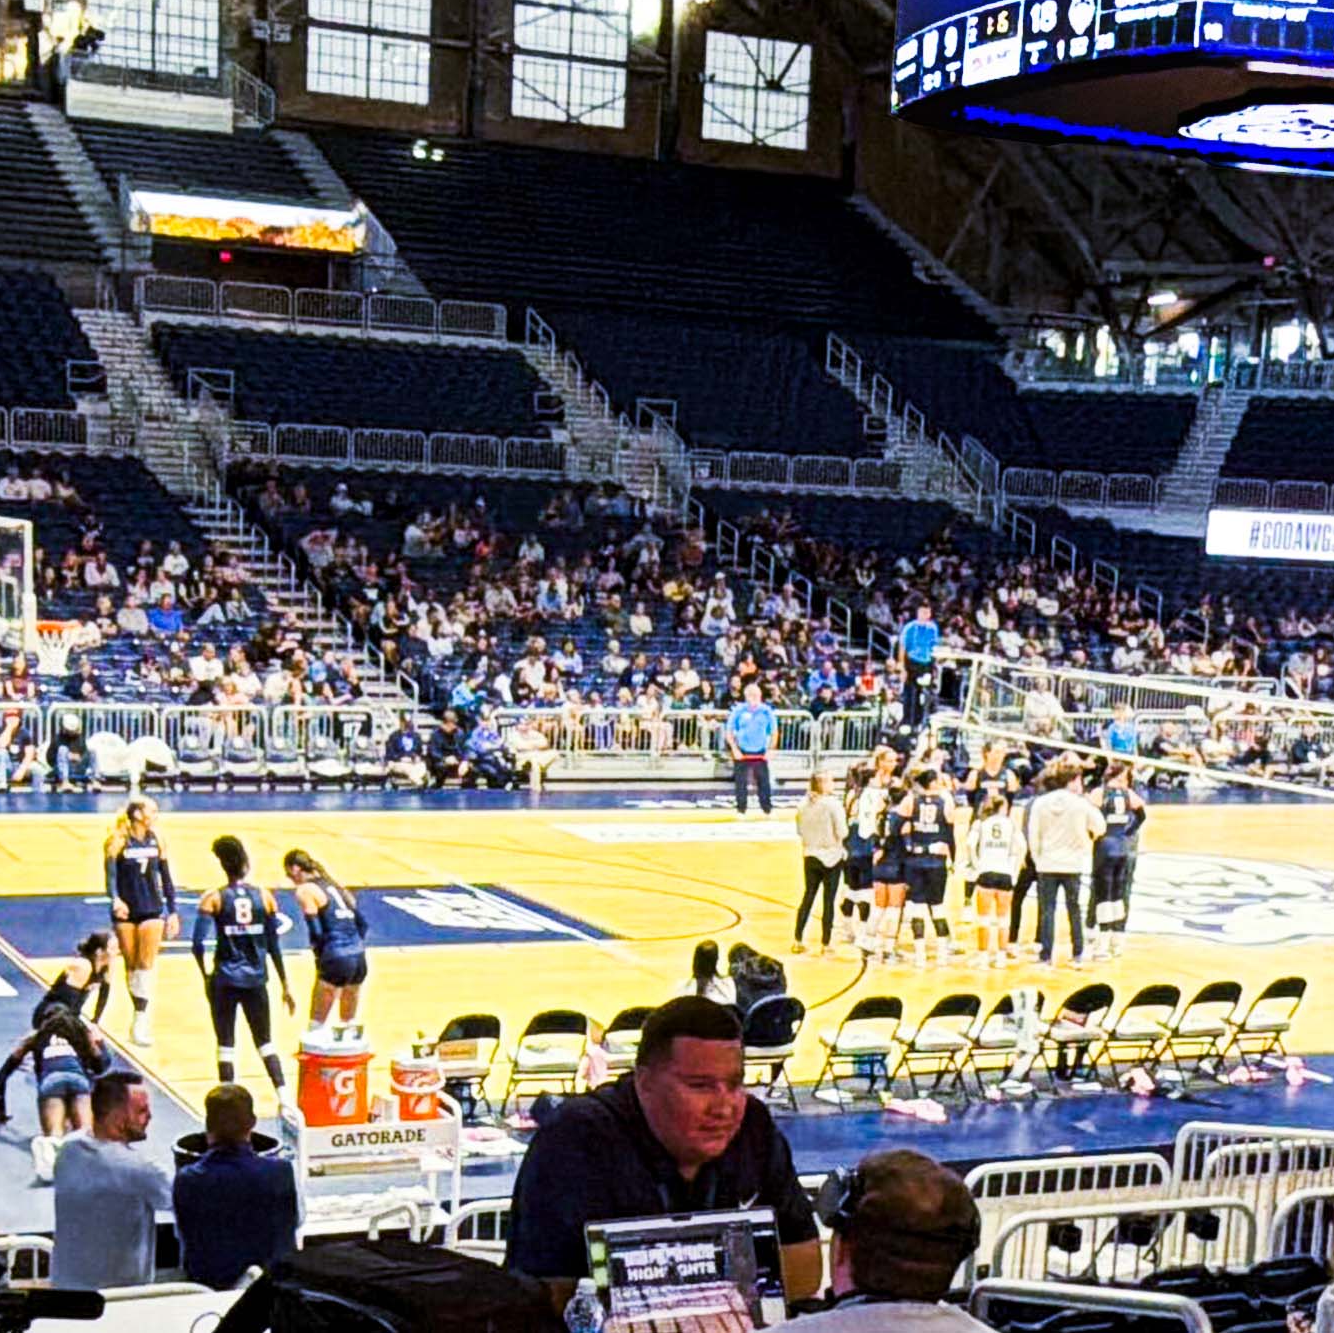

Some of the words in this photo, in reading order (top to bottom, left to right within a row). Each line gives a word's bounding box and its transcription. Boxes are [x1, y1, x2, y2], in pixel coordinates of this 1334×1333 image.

[1030, 0, 1058, 34] 18
[136, 857, 149, 875] 7
[233, 896, 253, 924] 8
[334, 1069, 356, 1095] G
[331, 1127, 427, 1148] GATORADE
